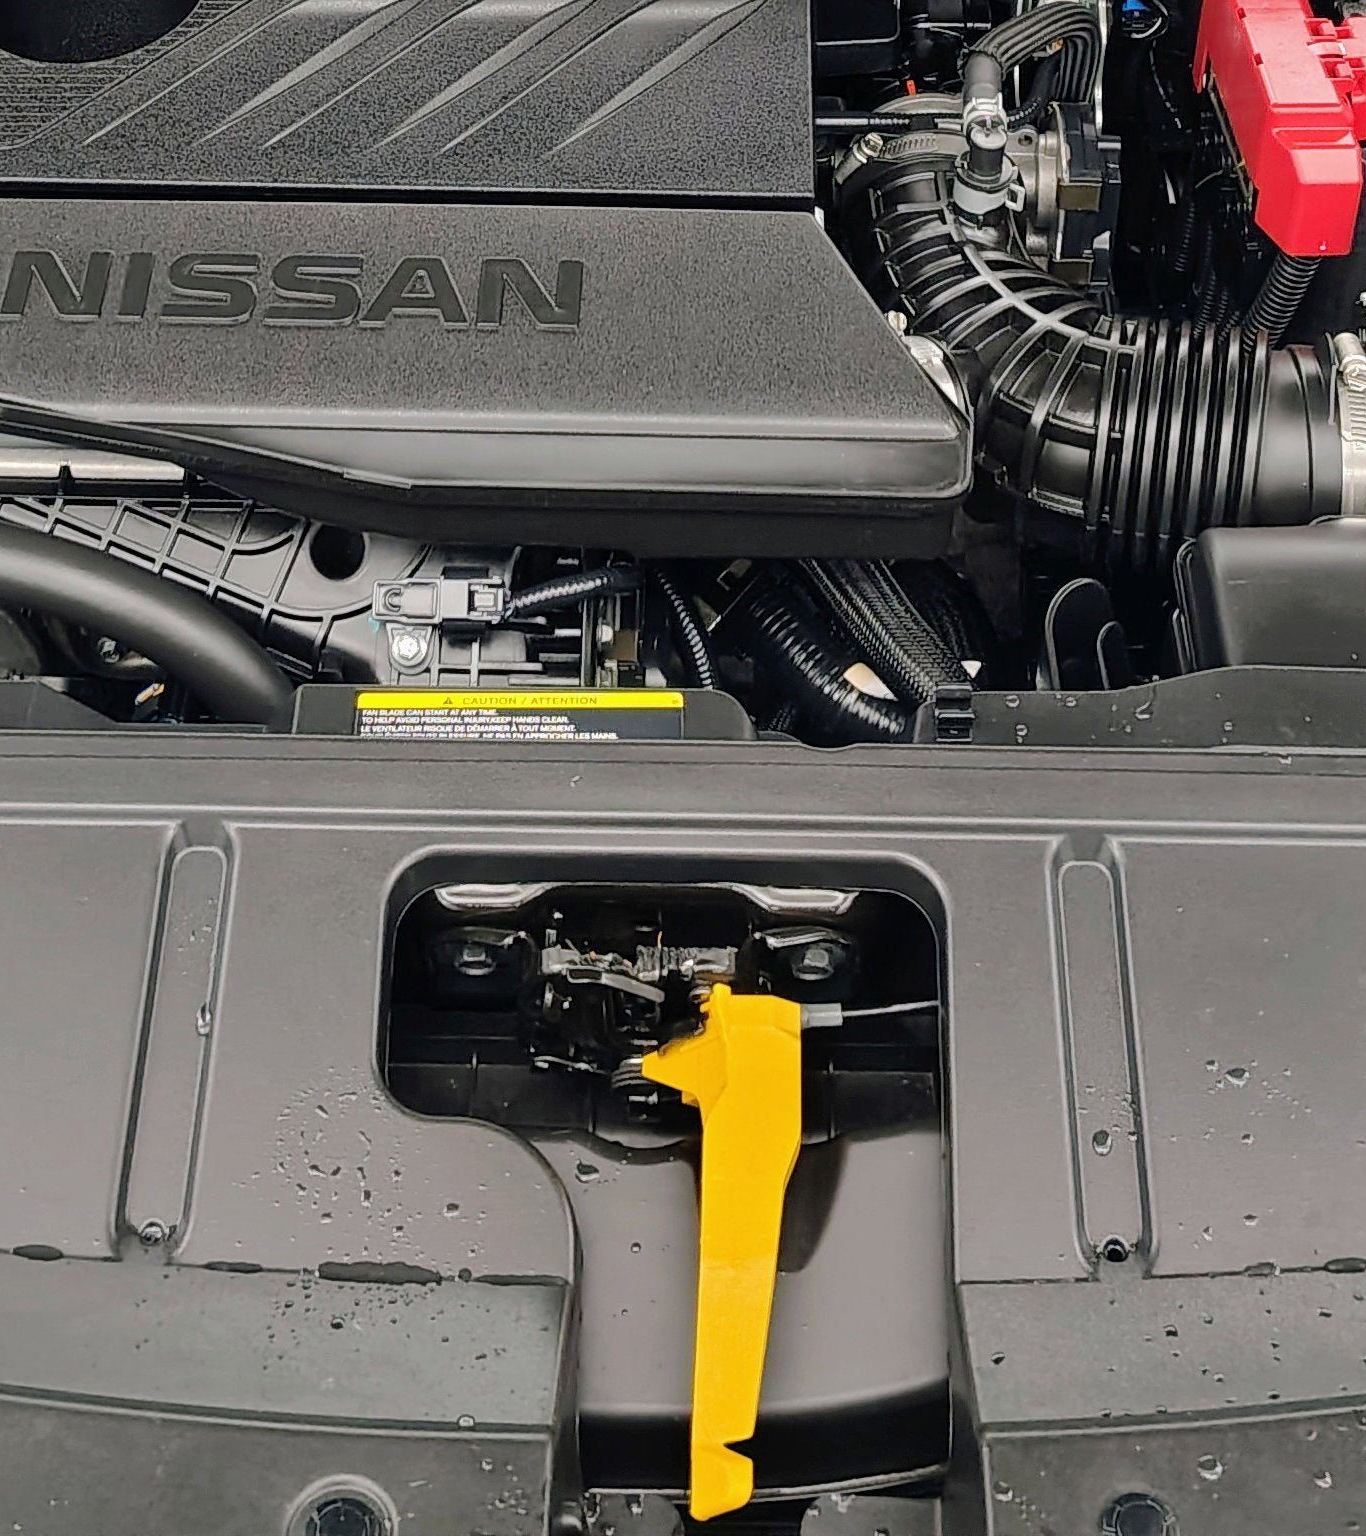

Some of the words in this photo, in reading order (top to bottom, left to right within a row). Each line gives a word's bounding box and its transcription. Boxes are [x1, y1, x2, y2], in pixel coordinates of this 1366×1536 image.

[462, 697, 517, 705] CAUTION
[530, 697, 597, 705] ATTENTION
[362, 716, 374, 724] TO
[374, 716, 396, 724] HELP
[396, 716, 420, 724] AVOID
